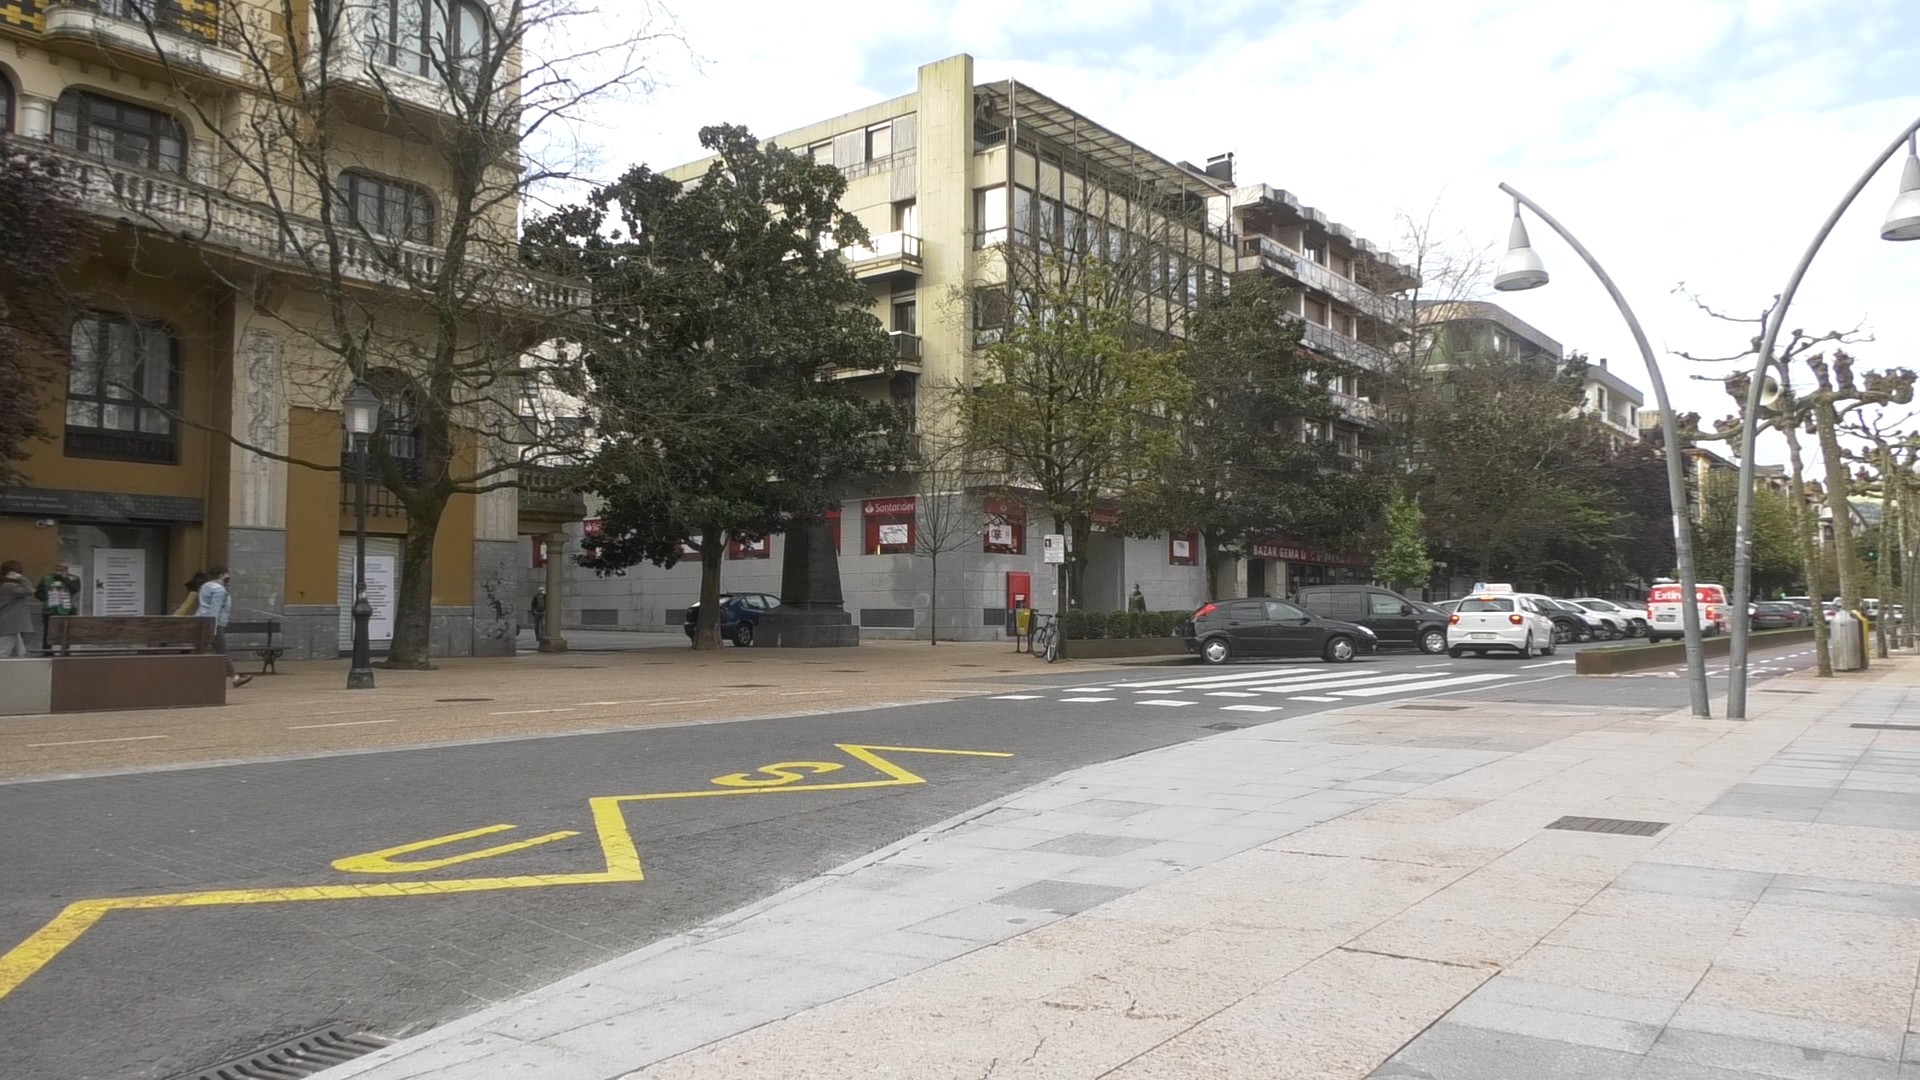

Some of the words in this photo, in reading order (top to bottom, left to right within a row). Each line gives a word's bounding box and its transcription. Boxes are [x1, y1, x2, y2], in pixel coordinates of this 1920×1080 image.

[874, 501, 915, 513] Santander
[1253, 545, 1278, 557] BAZAR
[1279, 547, 1299, 559] GEMA
